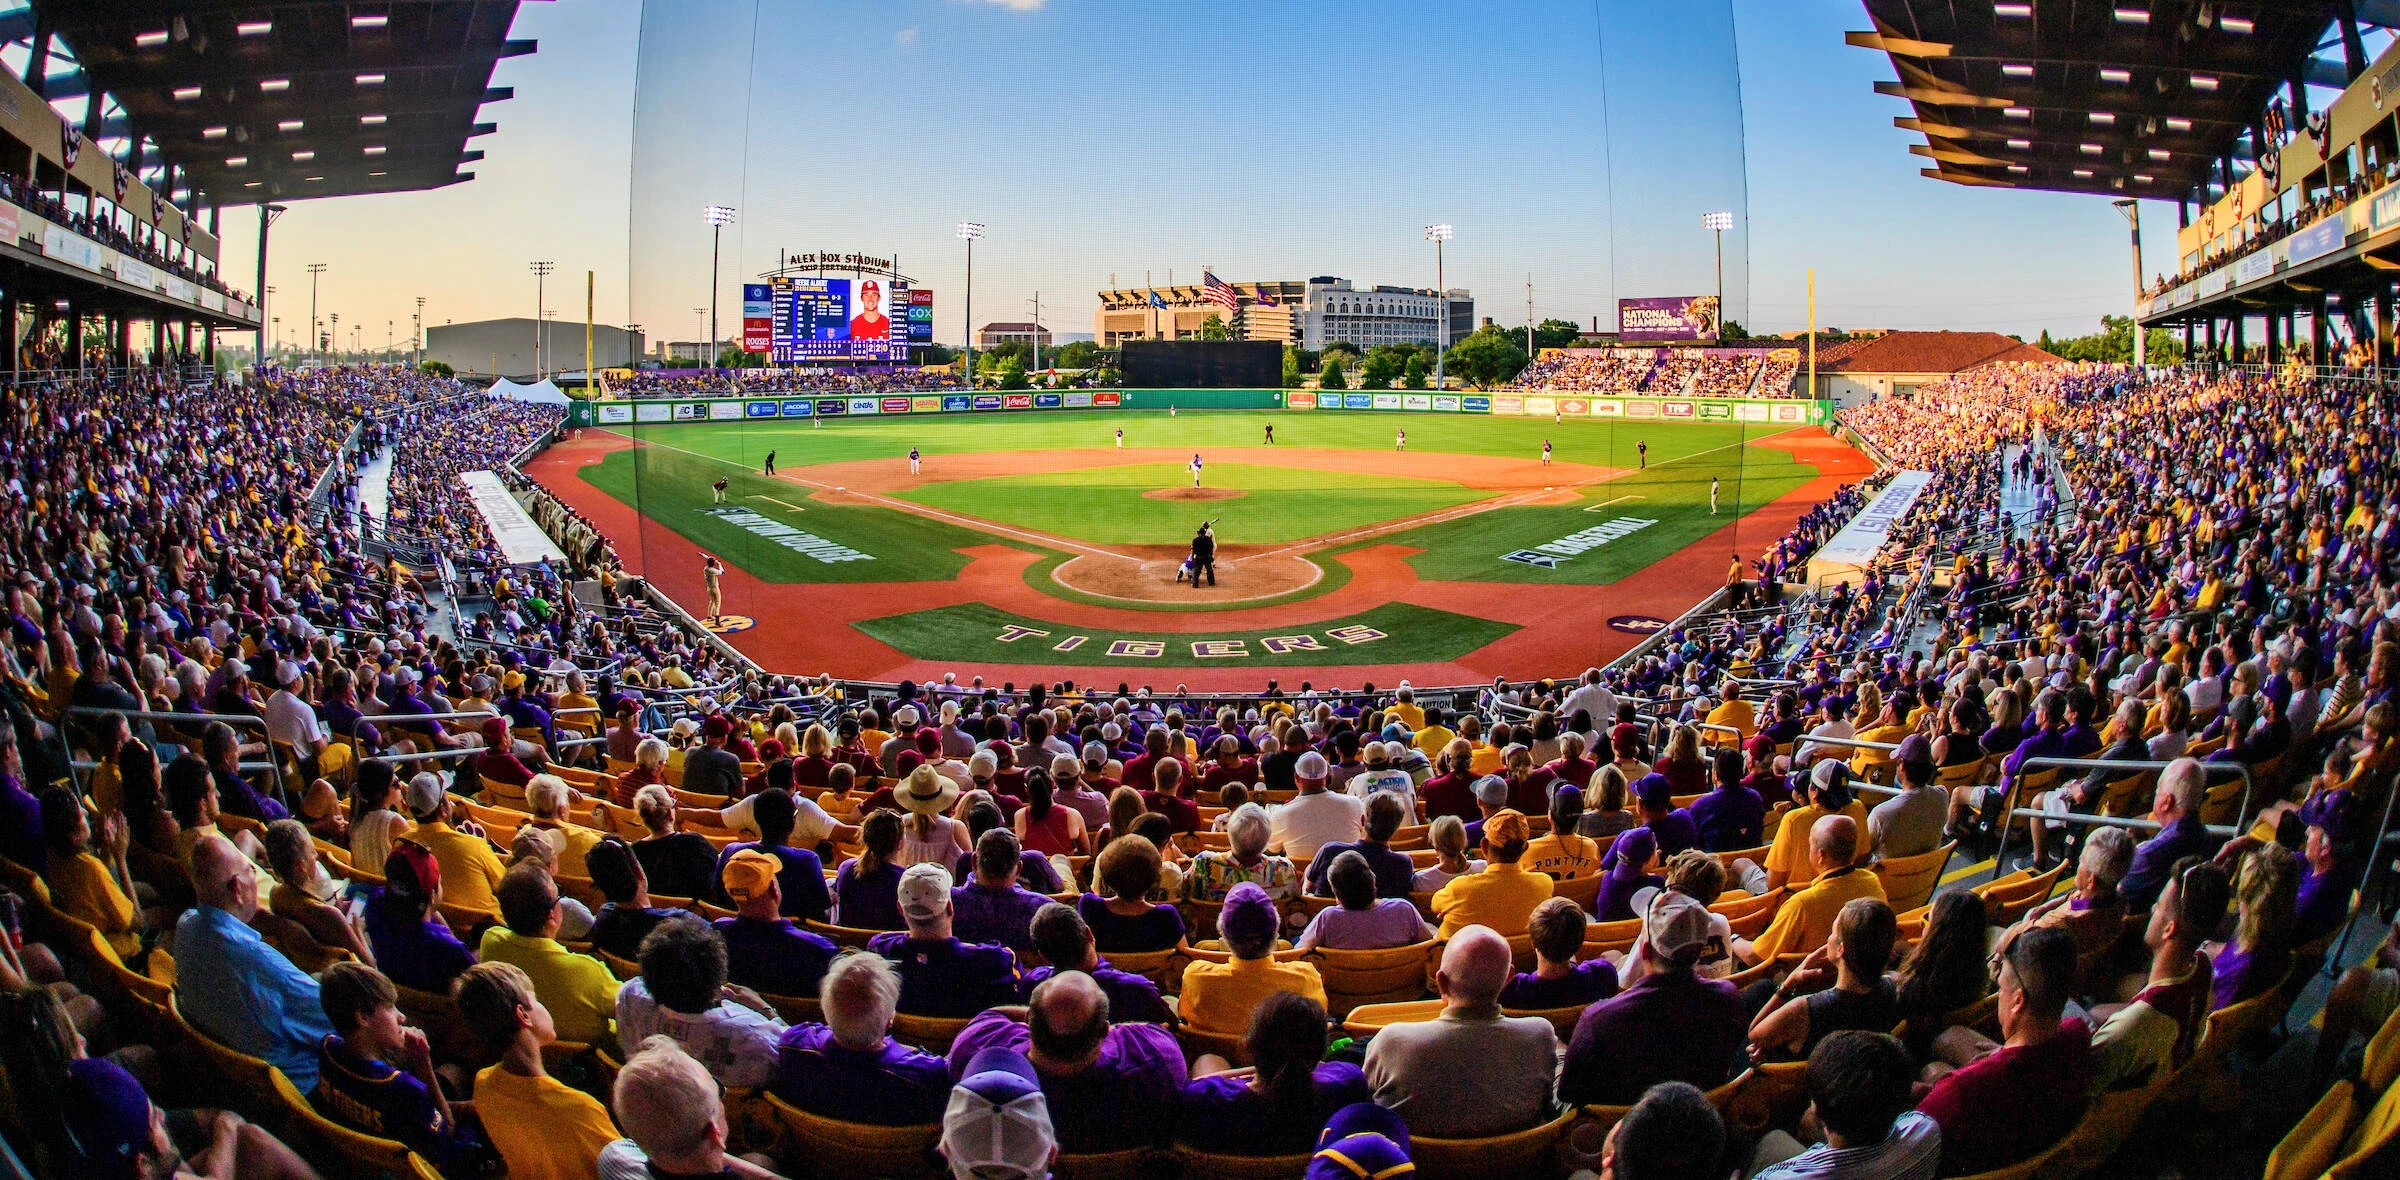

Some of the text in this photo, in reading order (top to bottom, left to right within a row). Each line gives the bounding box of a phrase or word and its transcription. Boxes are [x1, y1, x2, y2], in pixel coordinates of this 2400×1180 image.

[790, 253, 890, 269] ALEX BOX STADIUM
[908, 308, 933, 318] COX
[1622, 309, 1672, 319] NATIONAL
[1622, 317, 1683, 328] CHAMPIONS
[745, 337, 770, 346] ROUSES
[868, 344, 874, 352] 2
[875, 344, 881, 352] 2
[741, 367, 765, 377] LEFT
[1851, 483, 1919, 534] LSU BASEBALL
[1533, 516, 1660, 556] BASEBALL
[996, 624, 1388, 658] TIGERS
[1416, 700, 1451, 710] CAUTION
[1377, 776, 1406, 786] ACTION
[1535, 856, 1591, 870] PONTIFF
